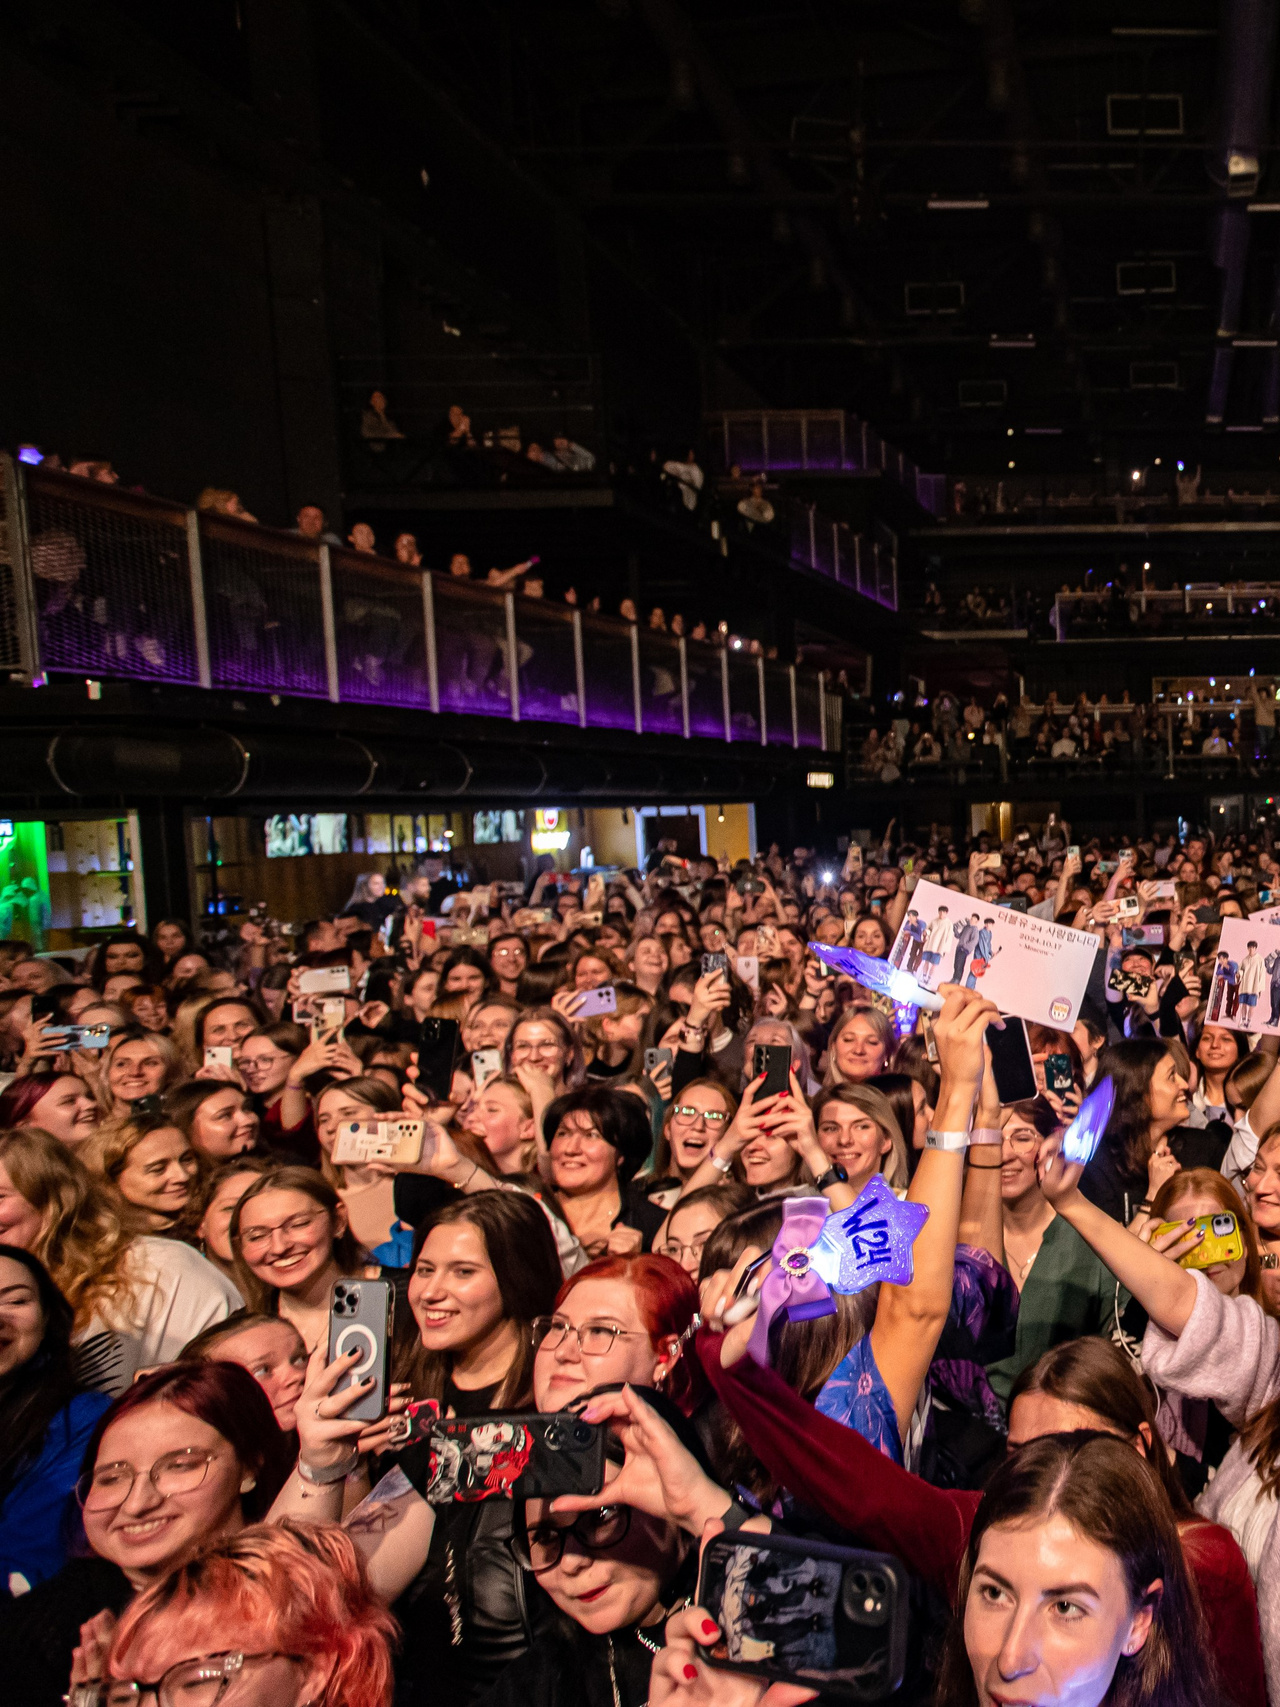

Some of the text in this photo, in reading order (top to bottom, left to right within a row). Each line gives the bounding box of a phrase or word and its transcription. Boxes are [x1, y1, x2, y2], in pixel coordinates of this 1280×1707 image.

[998, 911, 1097, 949] 더블유 24 사랑합니다
[1019, 933, 1062, 950] 2024.10.17
[1024, 944, 1049, 956] Moscow
[842, 1197, 892, 1270] W24
